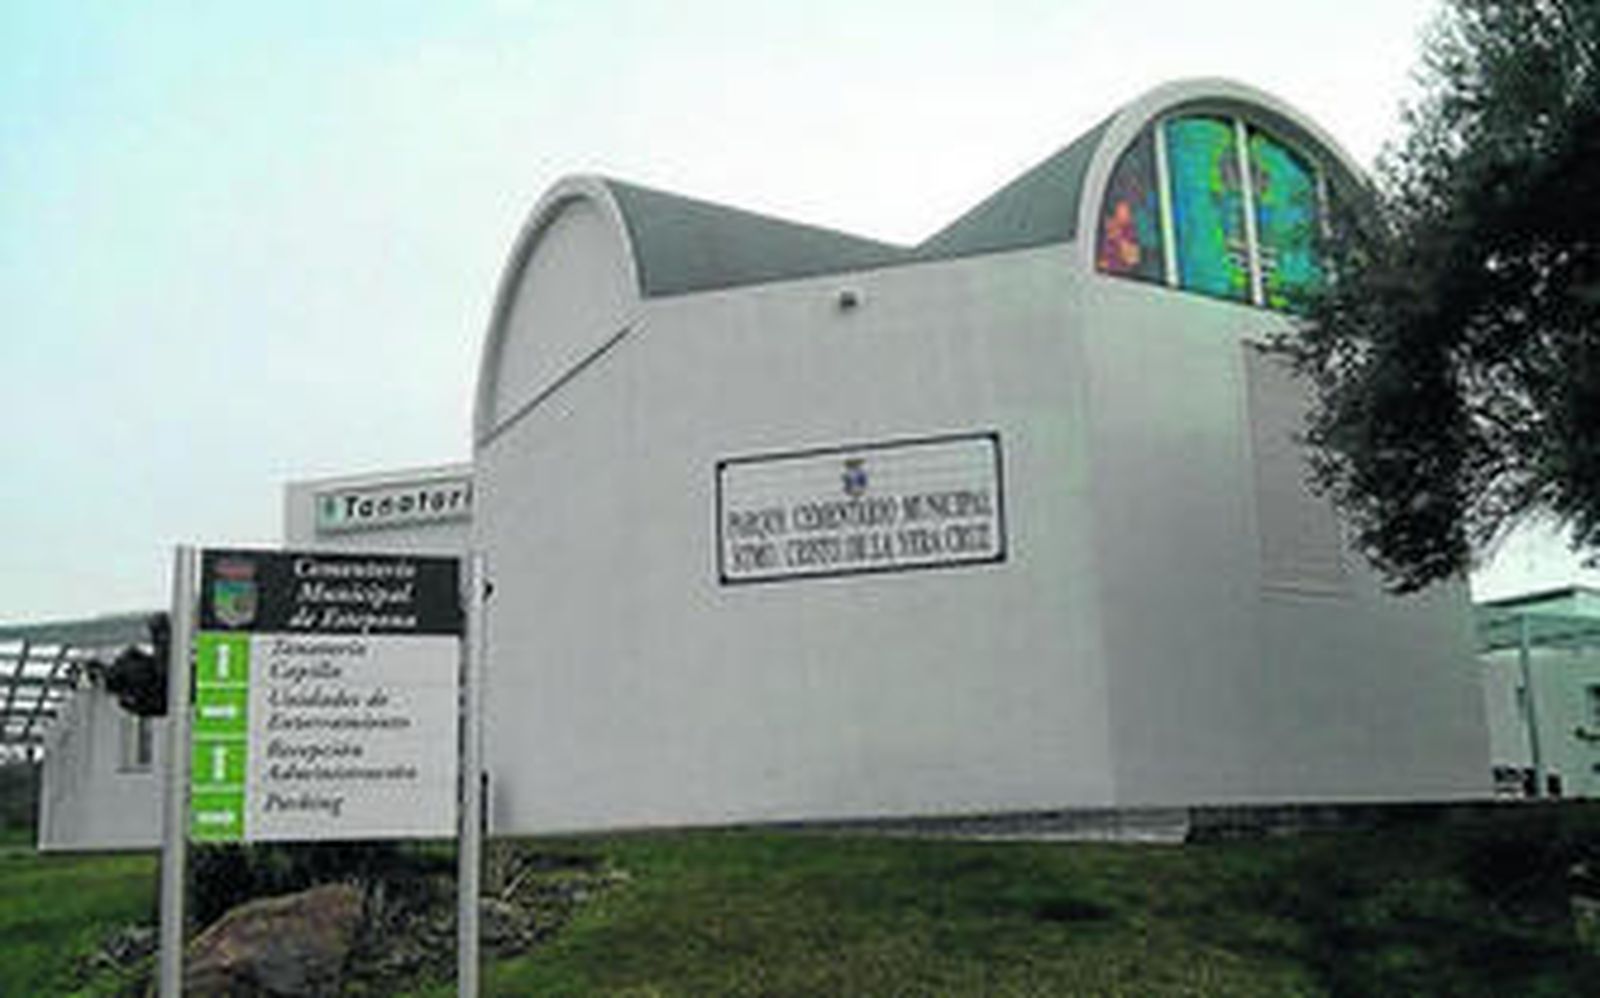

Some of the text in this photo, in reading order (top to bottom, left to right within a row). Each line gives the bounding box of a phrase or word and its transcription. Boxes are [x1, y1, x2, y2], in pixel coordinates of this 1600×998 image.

[903, 490, 993, 519] MUNICIPAL
[293, 557, 417, 578] Cementerio
[296, 581, 413, 608] Municipal
[289, 606, 316, 627] de
[269, 660, 342, 683] Capilla
[367, 687, 389, 707] de
